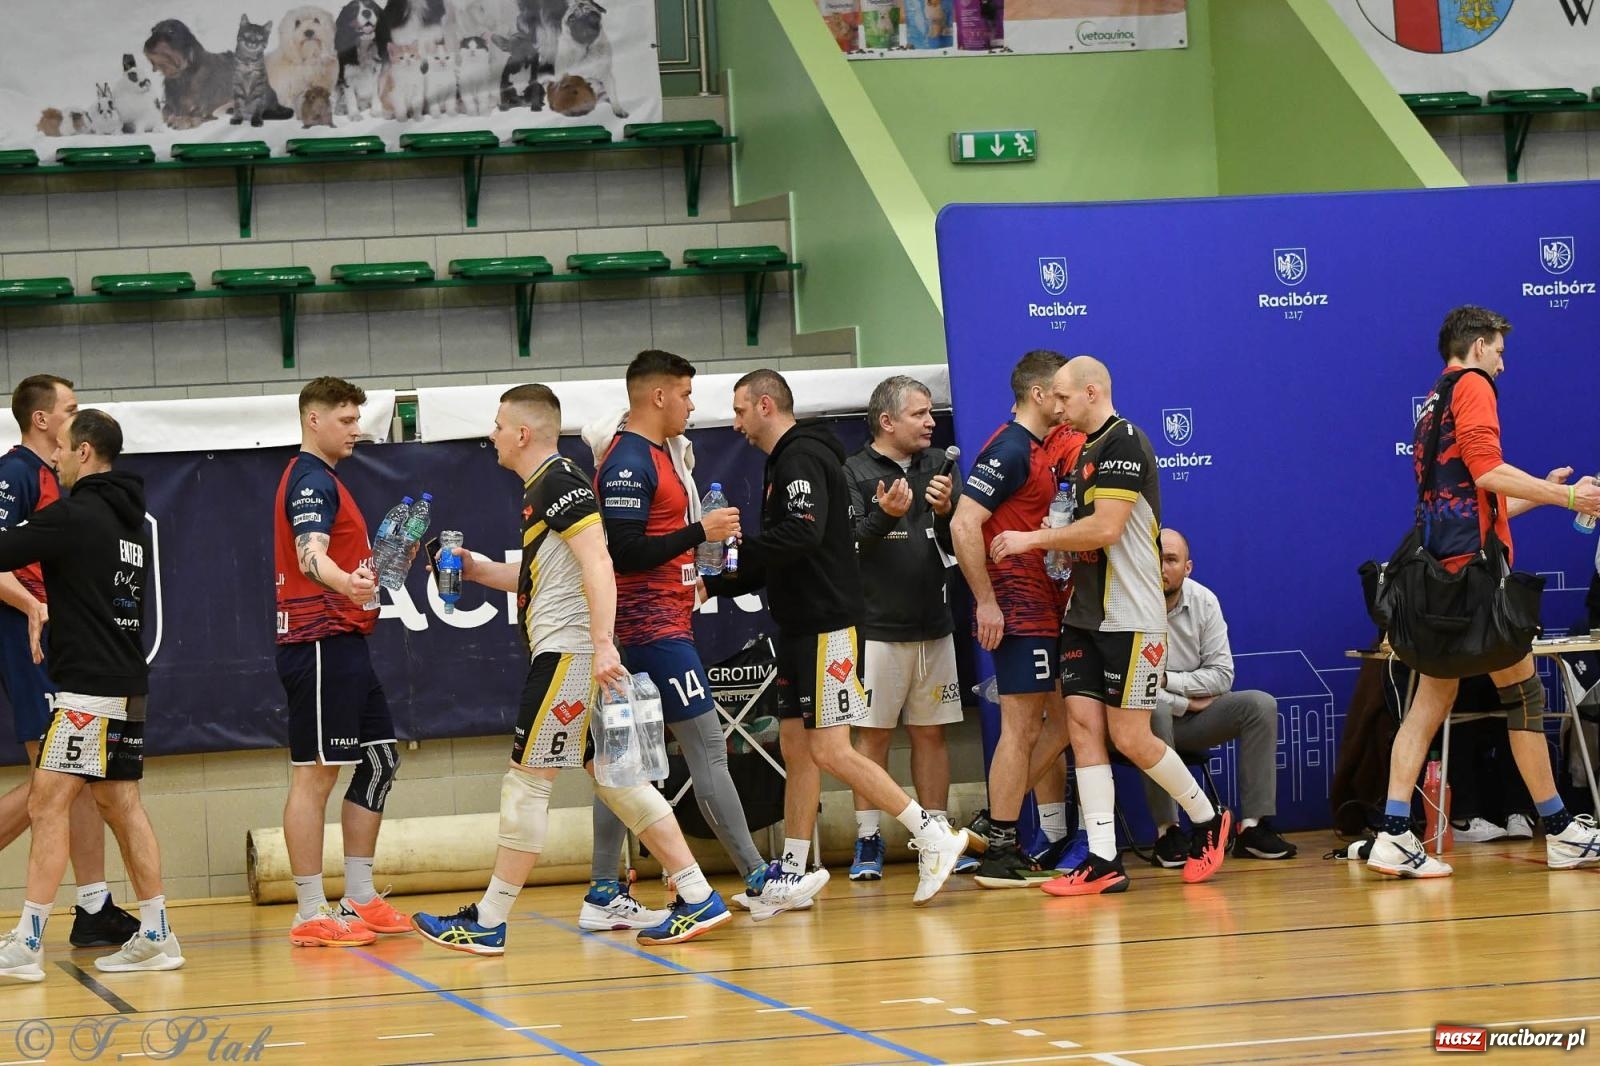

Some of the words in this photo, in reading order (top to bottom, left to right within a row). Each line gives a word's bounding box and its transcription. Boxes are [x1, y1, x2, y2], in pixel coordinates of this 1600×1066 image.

[1522, 280, 1597, 296] Racibórz
[1258, 291, 1329, 308] Racibórz
[1549, 299, 1570, 309] 1217
[1028, 301, 1088, 317] Racibórz
[1284, 310, 1303, 321] 1217
[1050, 320, 1067, 332] 1217
[606, 480, 642, 489] KATOLIK
[1172, 471, 1190, 482] 1217
[786, 479, 812, 500] ENTER
[119, 539, 144, 568] ENTER
[1032, 648, 1051, 680] 3
[668, 669, 706, 707] 14
[1145, 673, 1158, 698] 2
[837, 688, 850, 713] 8
[66, 735, 85, 762] 5
[330, 737, 359, 746] ITALIA
[550, 731, 568, 756] 6
